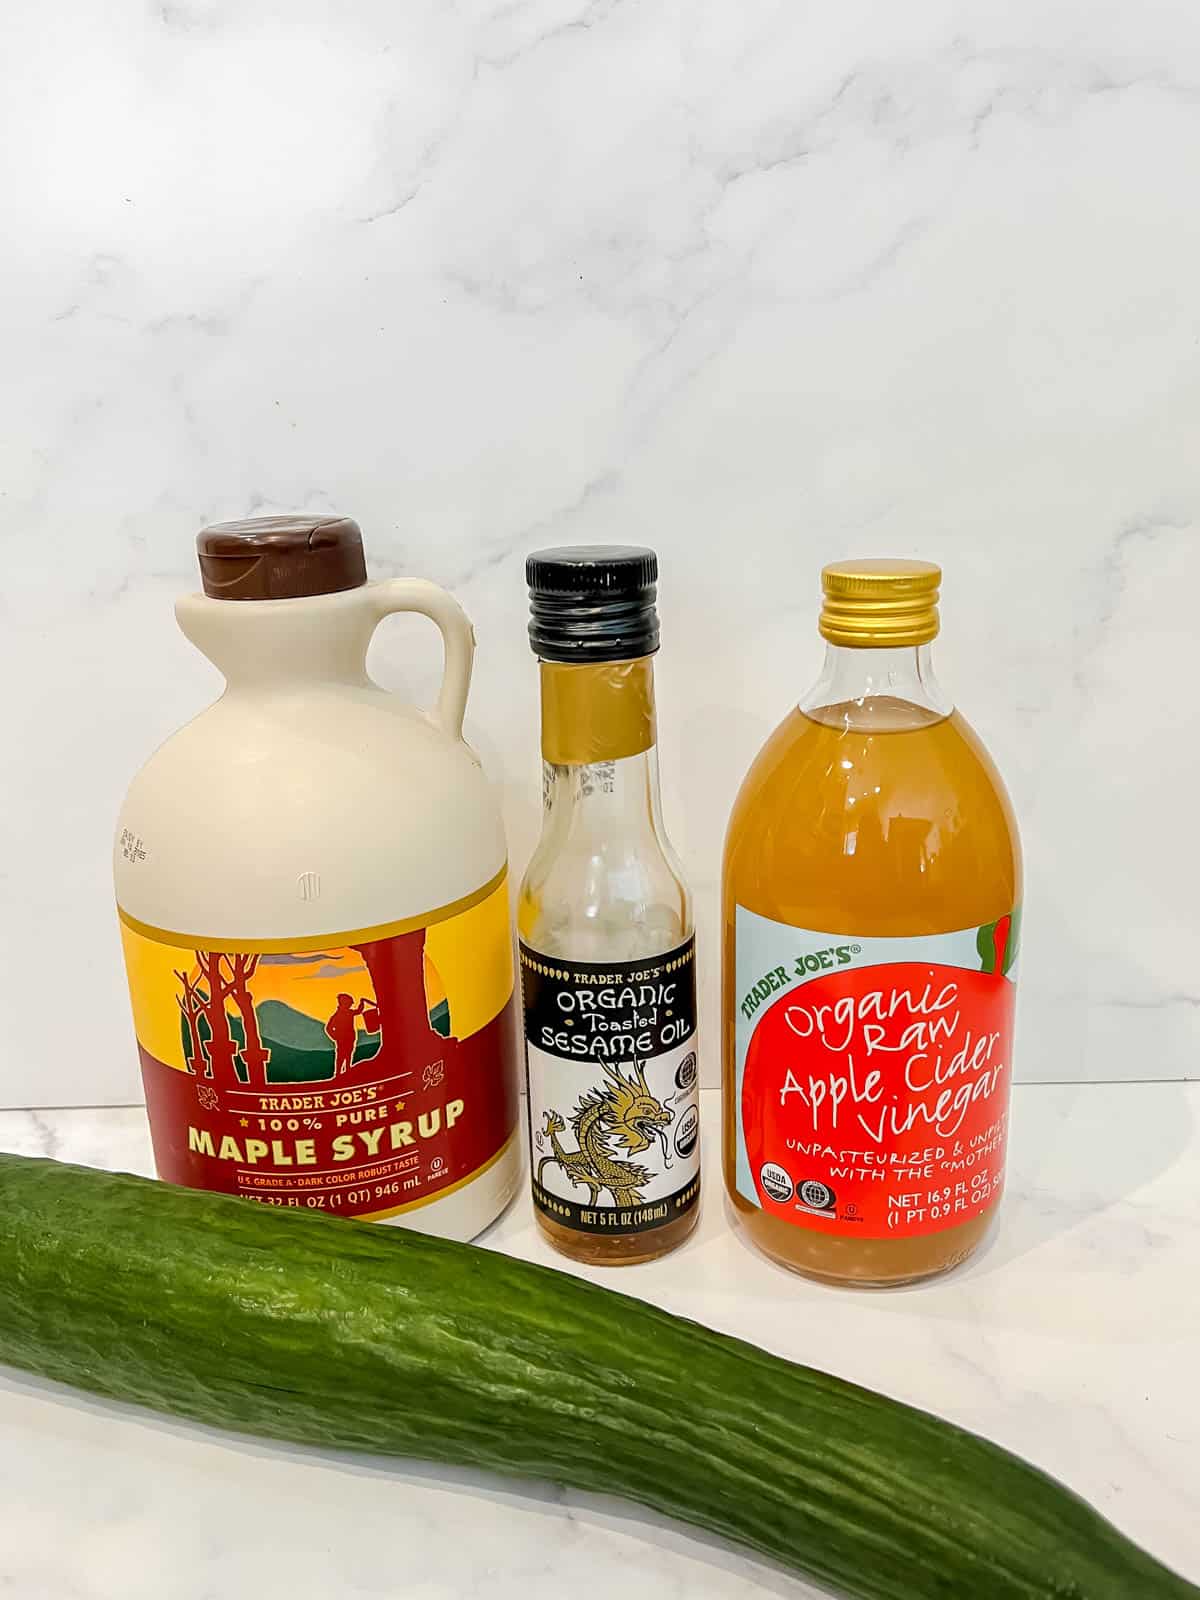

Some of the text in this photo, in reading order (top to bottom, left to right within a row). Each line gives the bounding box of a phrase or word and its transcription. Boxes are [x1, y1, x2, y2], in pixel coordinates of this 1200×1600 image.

[574, 968, 660, 985] TRADER JOE'S
[557, 983, 677, 1013] ORGANIC
[740, 966, 792, 1021] TRADER
[582, 1008, 657, 1032] Toasted
[784, 970, 958, 1051] Organic
[541, 1018, 690, 1056] SESAME OIL
[863, 1010, 960, 1056] Raw
[780, 1031, 1000, 1131] Apple Cider
[259, 1086, 377, 1111] TRADER JOE'S
[188, 1099, 465, 1165] MAPLE SYRUP
[258, 1105, 389, 1132] 100% PURE
[786, 1138, 945, 1165] UNPASTEURIZED
[953, 1141, 963, 1156] &
[254, 1178, 285, 1187] GRADE
[326, 1172, 356, 1184] COLOR
[358, 1165, 392, 1180] ROBUST
[393, 1155, 419, 1171] TASTE
[829, 1166, 885, 1181] WITH
[893, 1165, 933, 1178] THE
[307, 1196, 325, 1208] OZ
[330, 1194, 341, 1208] (1
[347, 1189, 371, 1204] QT)
[375, 1182, 399, 1198] 946
[403, 1175, 421, 1190] mL
[888, 1193, 922, 1208] NET
[927, 1187, 951, 1204] 16.9
[955, 1181, 969, 1197] FL
[971, 1169, 988, 1188] OZ
[580, 1211, 597, 1225] NET
[600, 1213, 606, 1225] 5
[608, 1213, 619, 1225] FL
[621, 1212, 632, 1225] OZ
[887, 1183, 991, 1228] (1 PT 0.9 FL OZ)
